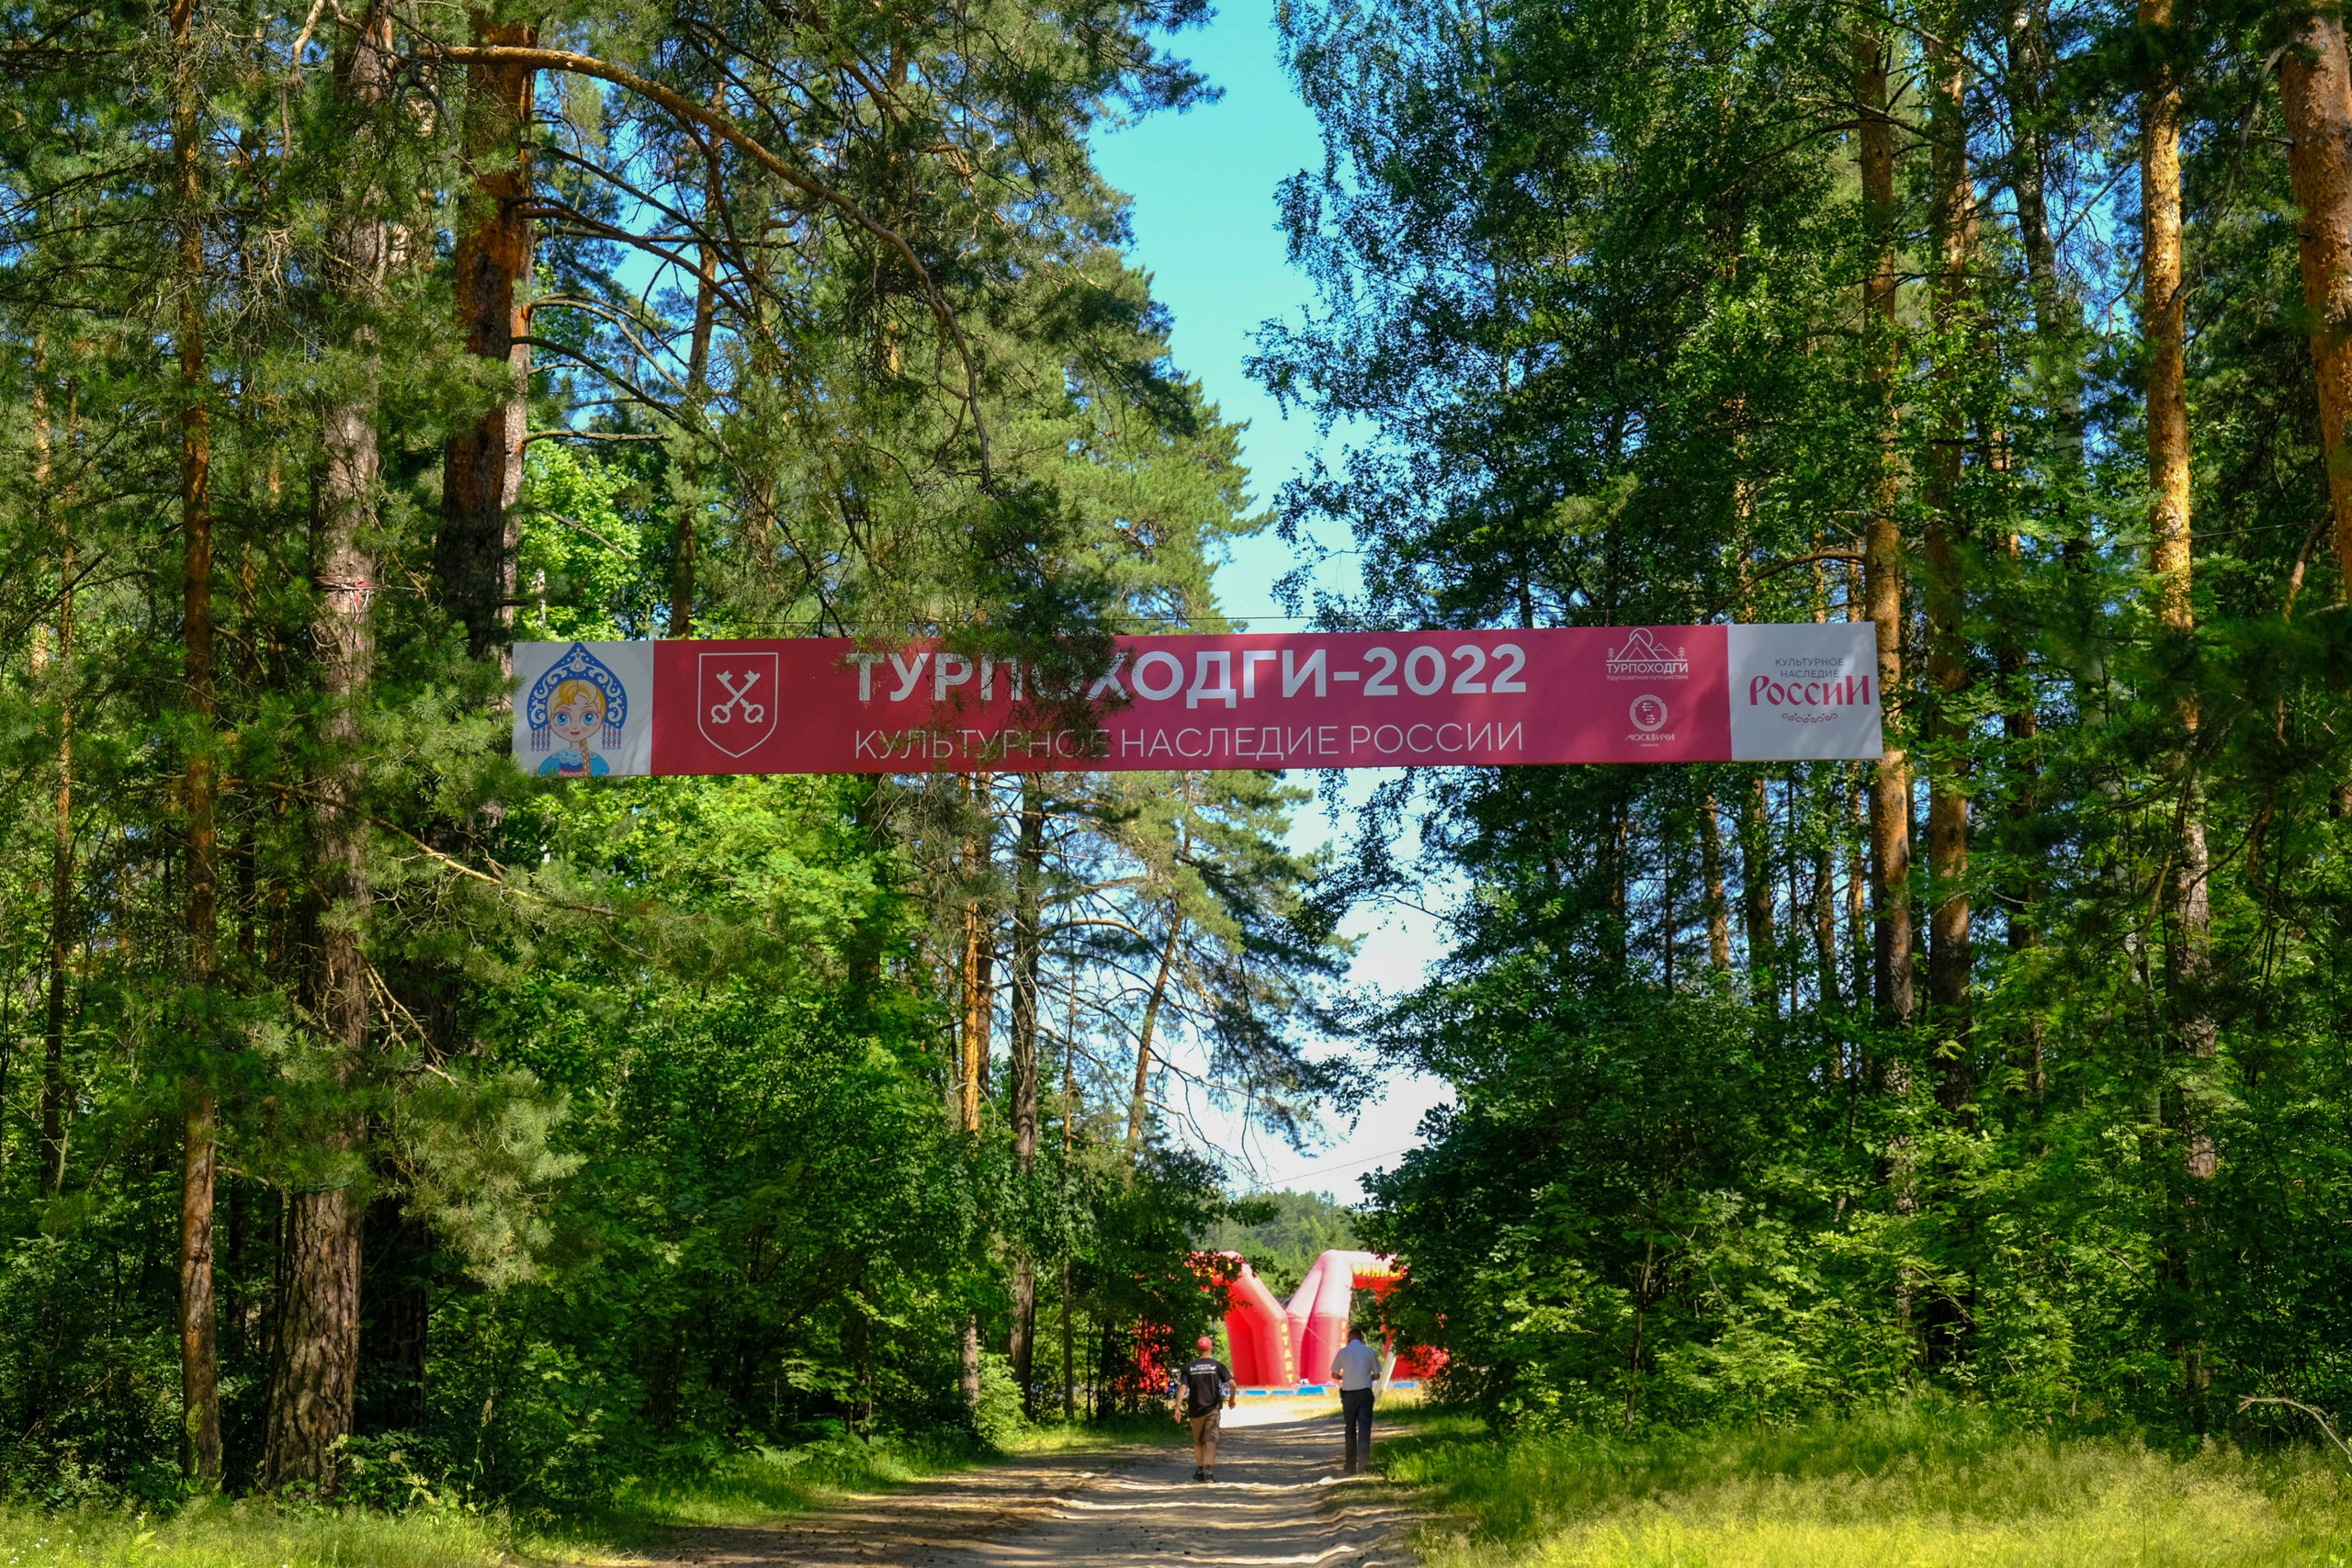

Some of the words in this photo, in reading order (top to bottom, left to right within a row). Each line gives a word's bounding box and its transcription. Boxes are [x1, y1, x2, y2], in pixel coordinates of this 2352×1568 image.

[1606, 662, 1689, 674] ТУРПОХОДГИ
[1775, 658, 1844, 667] КУЛЬТУРНОЕ
[1781, 670, 1839, 678] НАСЛЕДИЕ
[855, 728, 1110, 760] КУЛЬТУРНОЕ
[1122, 726, 1339, 761] НАСЛЕДИЕ
[1351, 722, 1522, 754] РОССИИ
[1281, 1323, 1294, 1383] START
